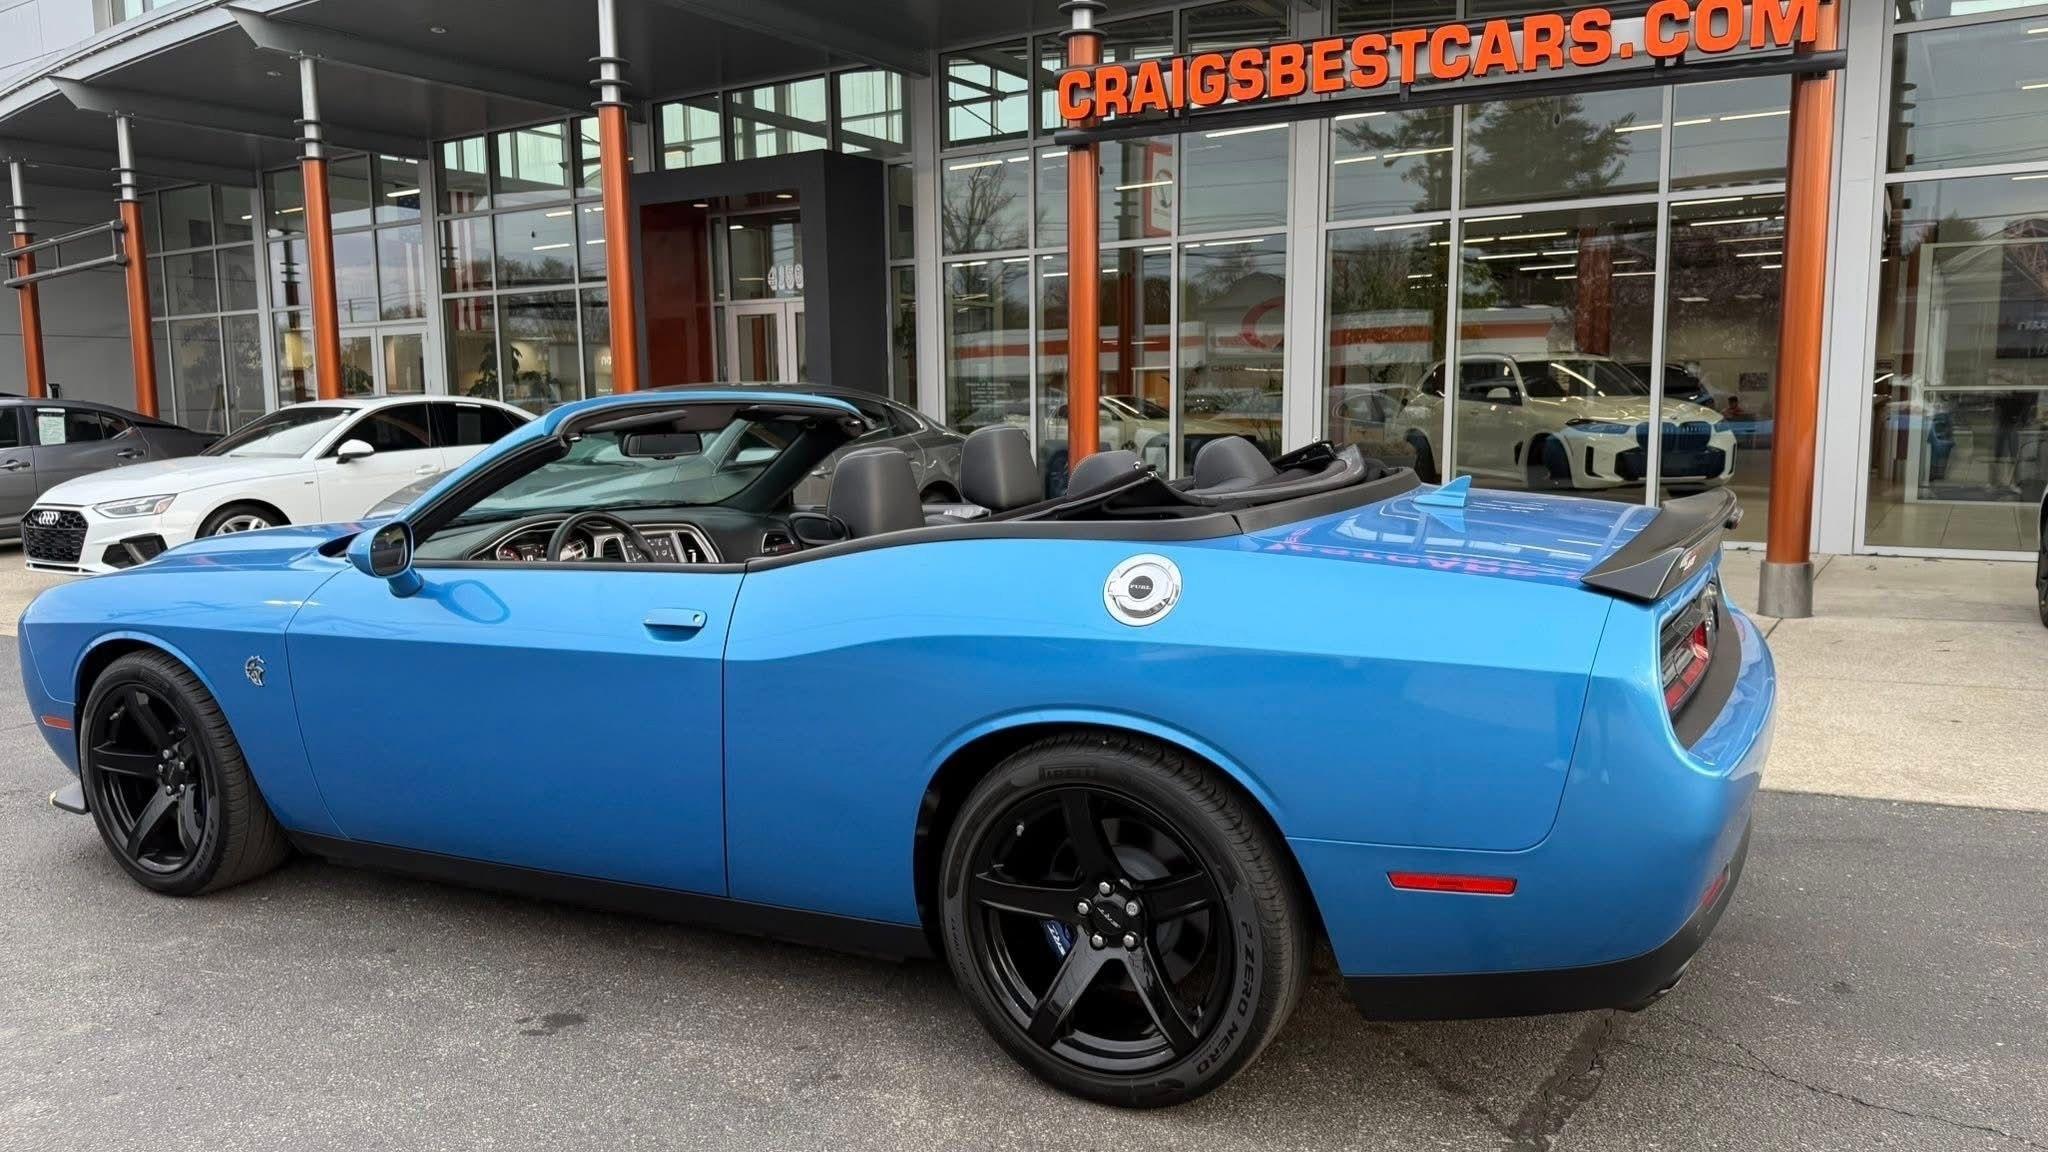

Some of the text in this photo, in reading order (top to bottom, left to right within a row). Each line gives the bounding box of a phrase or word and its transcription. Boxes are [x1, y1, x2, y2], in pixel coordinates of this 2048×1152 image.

[1058, 0, 1818, 120] CRAIGSBESTCARS.COM
[1196, 920, 1255, 1075] P ZERO NERO
